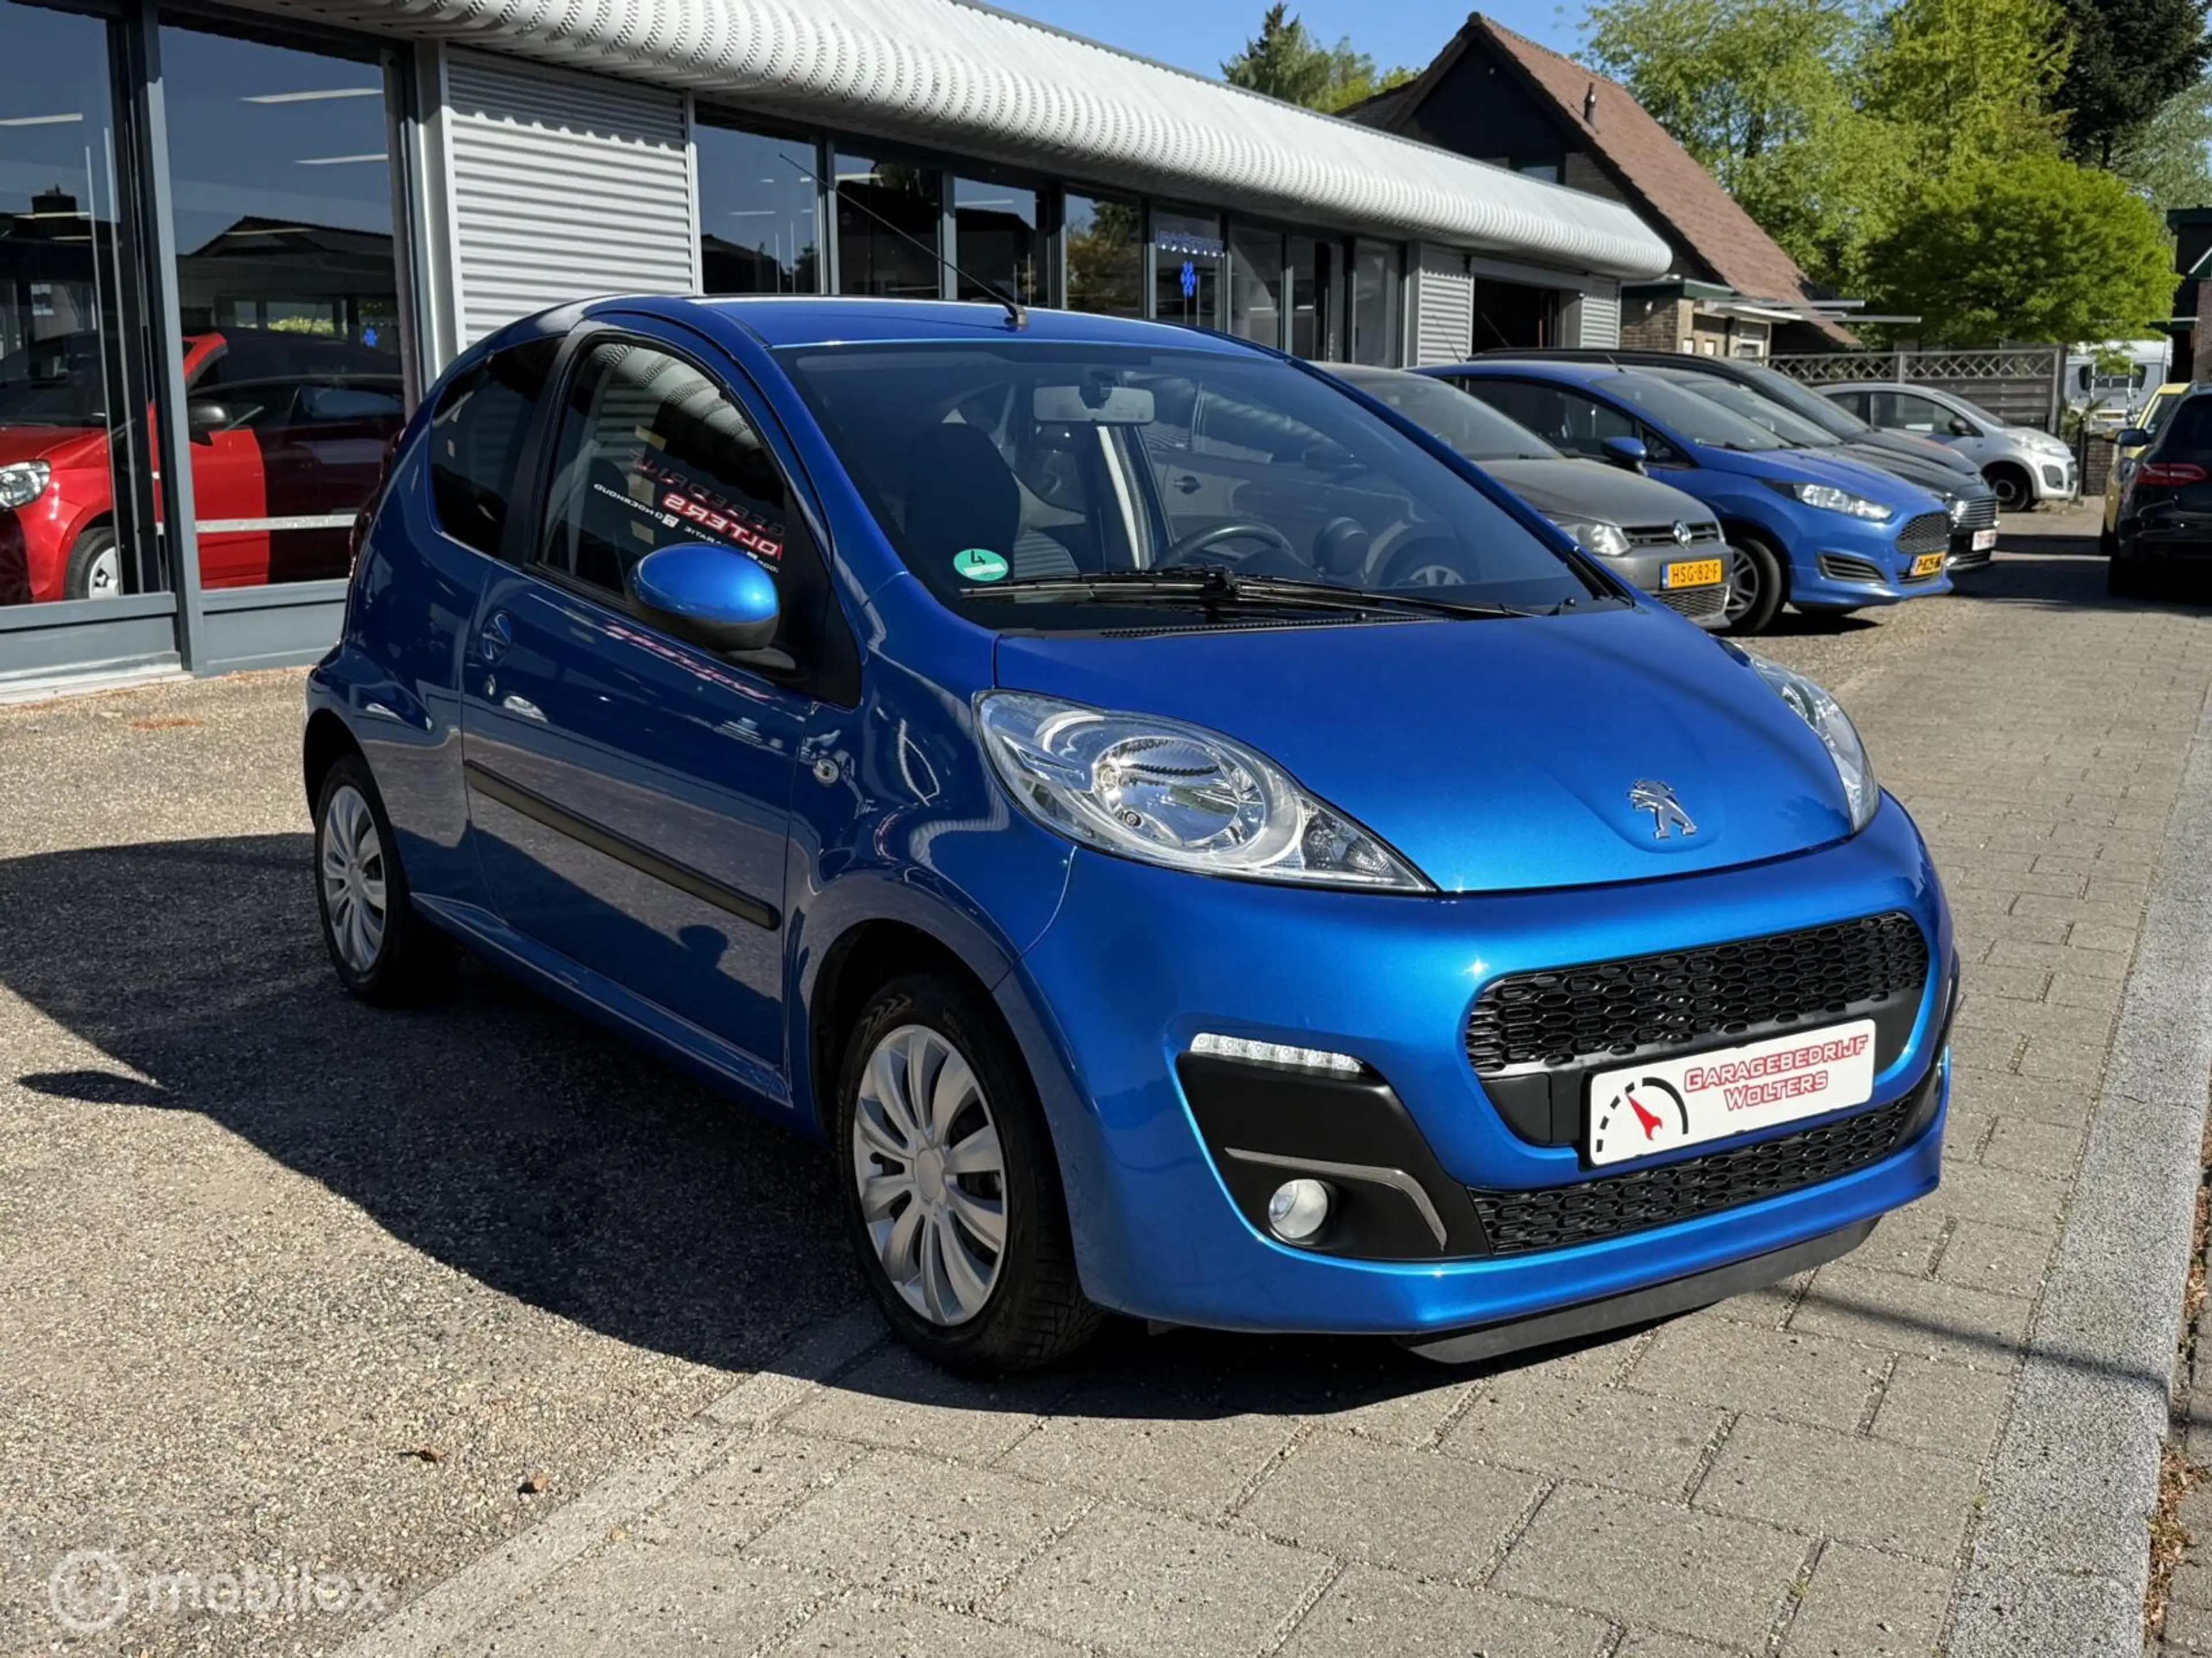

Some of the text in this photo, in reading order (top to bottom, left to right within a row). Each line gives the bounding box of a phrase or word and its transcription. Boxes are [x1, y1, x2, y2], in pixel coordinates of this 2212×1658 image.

[971, 550, 986, 564] 4
[1685, 1034, 1868, 1092] GARAGEBEDRIJF
[1724, 1071, 1828, 1111] WOLTERS
